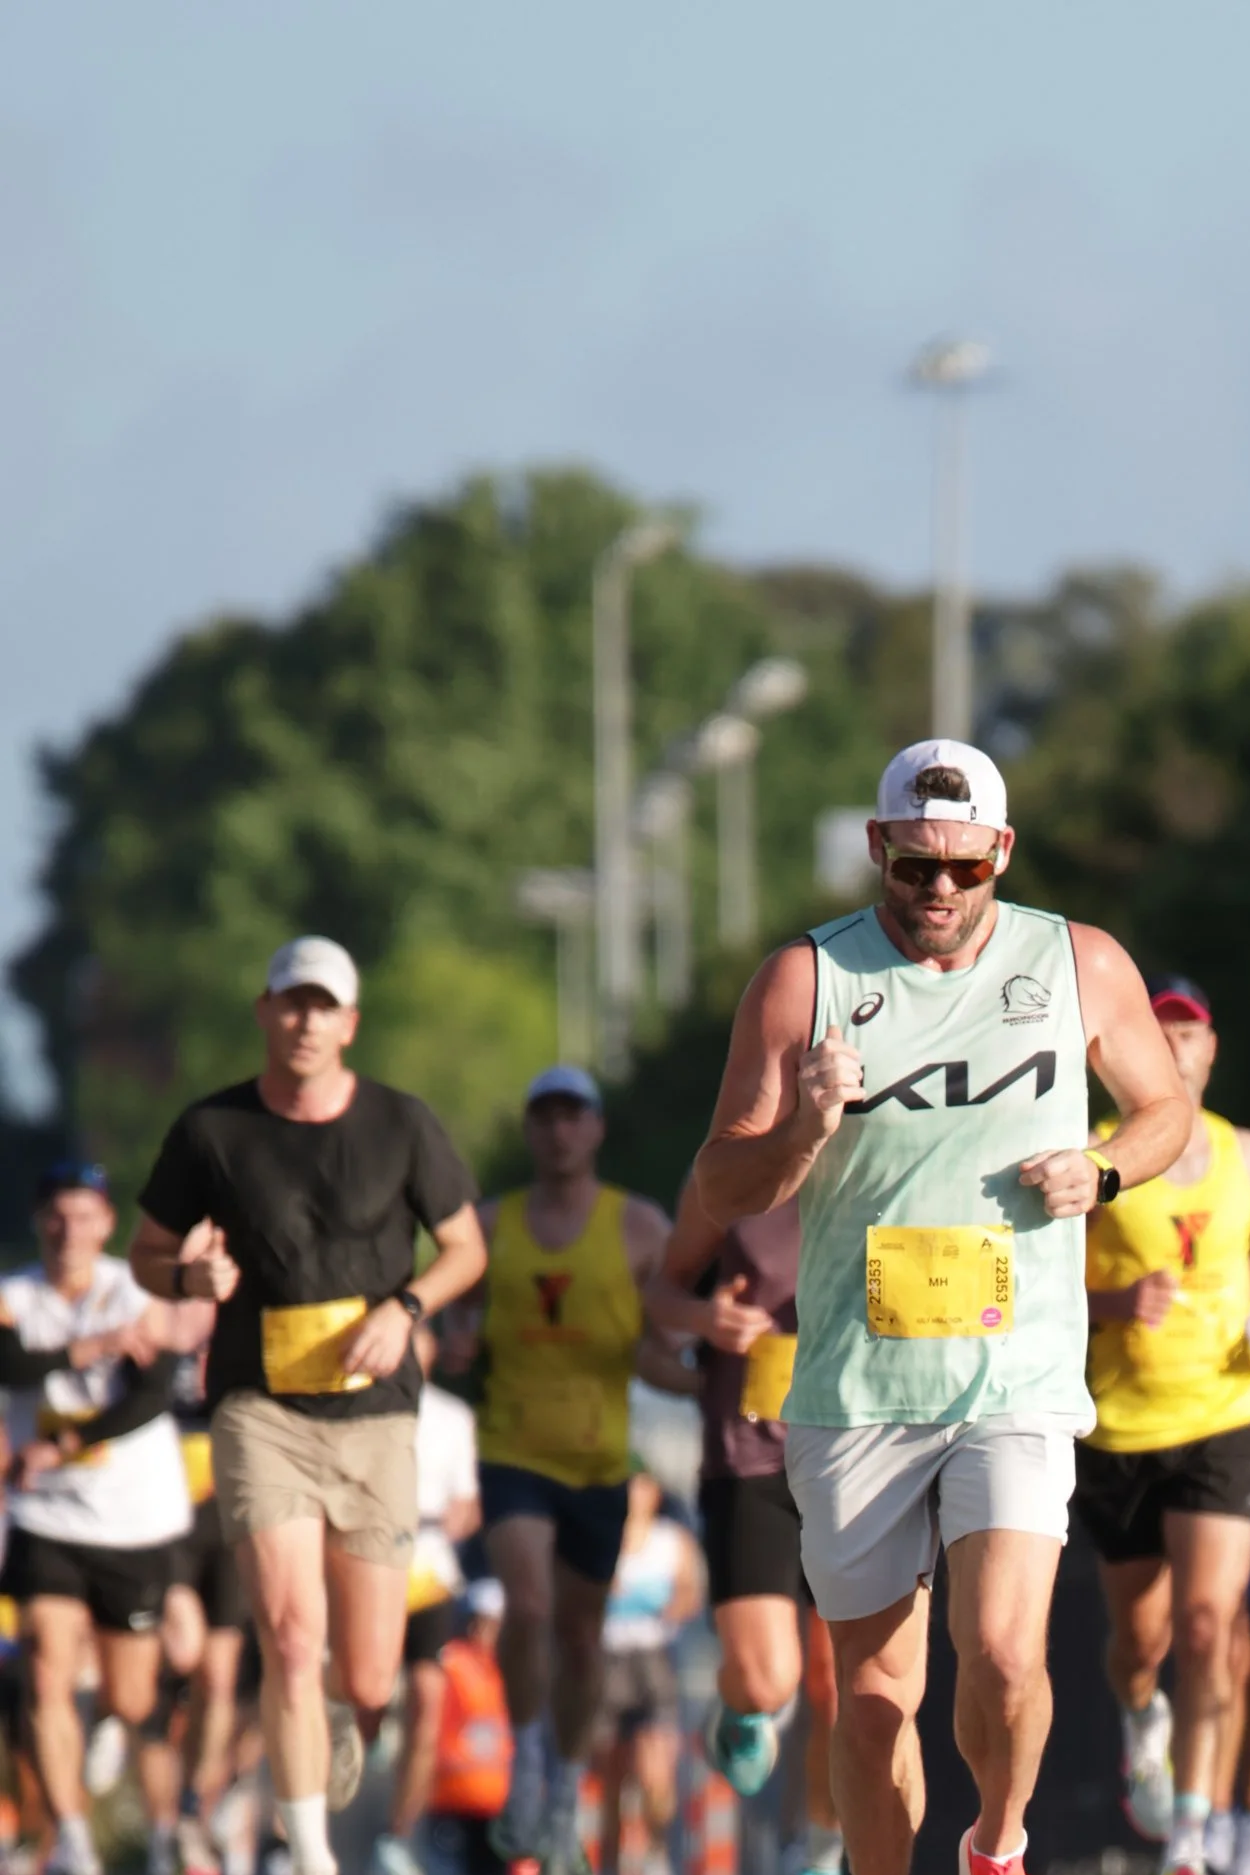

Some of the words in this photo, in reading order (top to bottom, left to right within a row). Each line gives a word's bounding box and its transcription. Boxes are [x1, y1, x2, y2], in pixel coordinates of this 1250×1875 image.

[843, 1050, 1056, 1114] KIA
[868, 1258, 882, 1305] 22353
[928, 1277, 949, 1288] MH
[995, 1256, 1009, 1303] 22353
